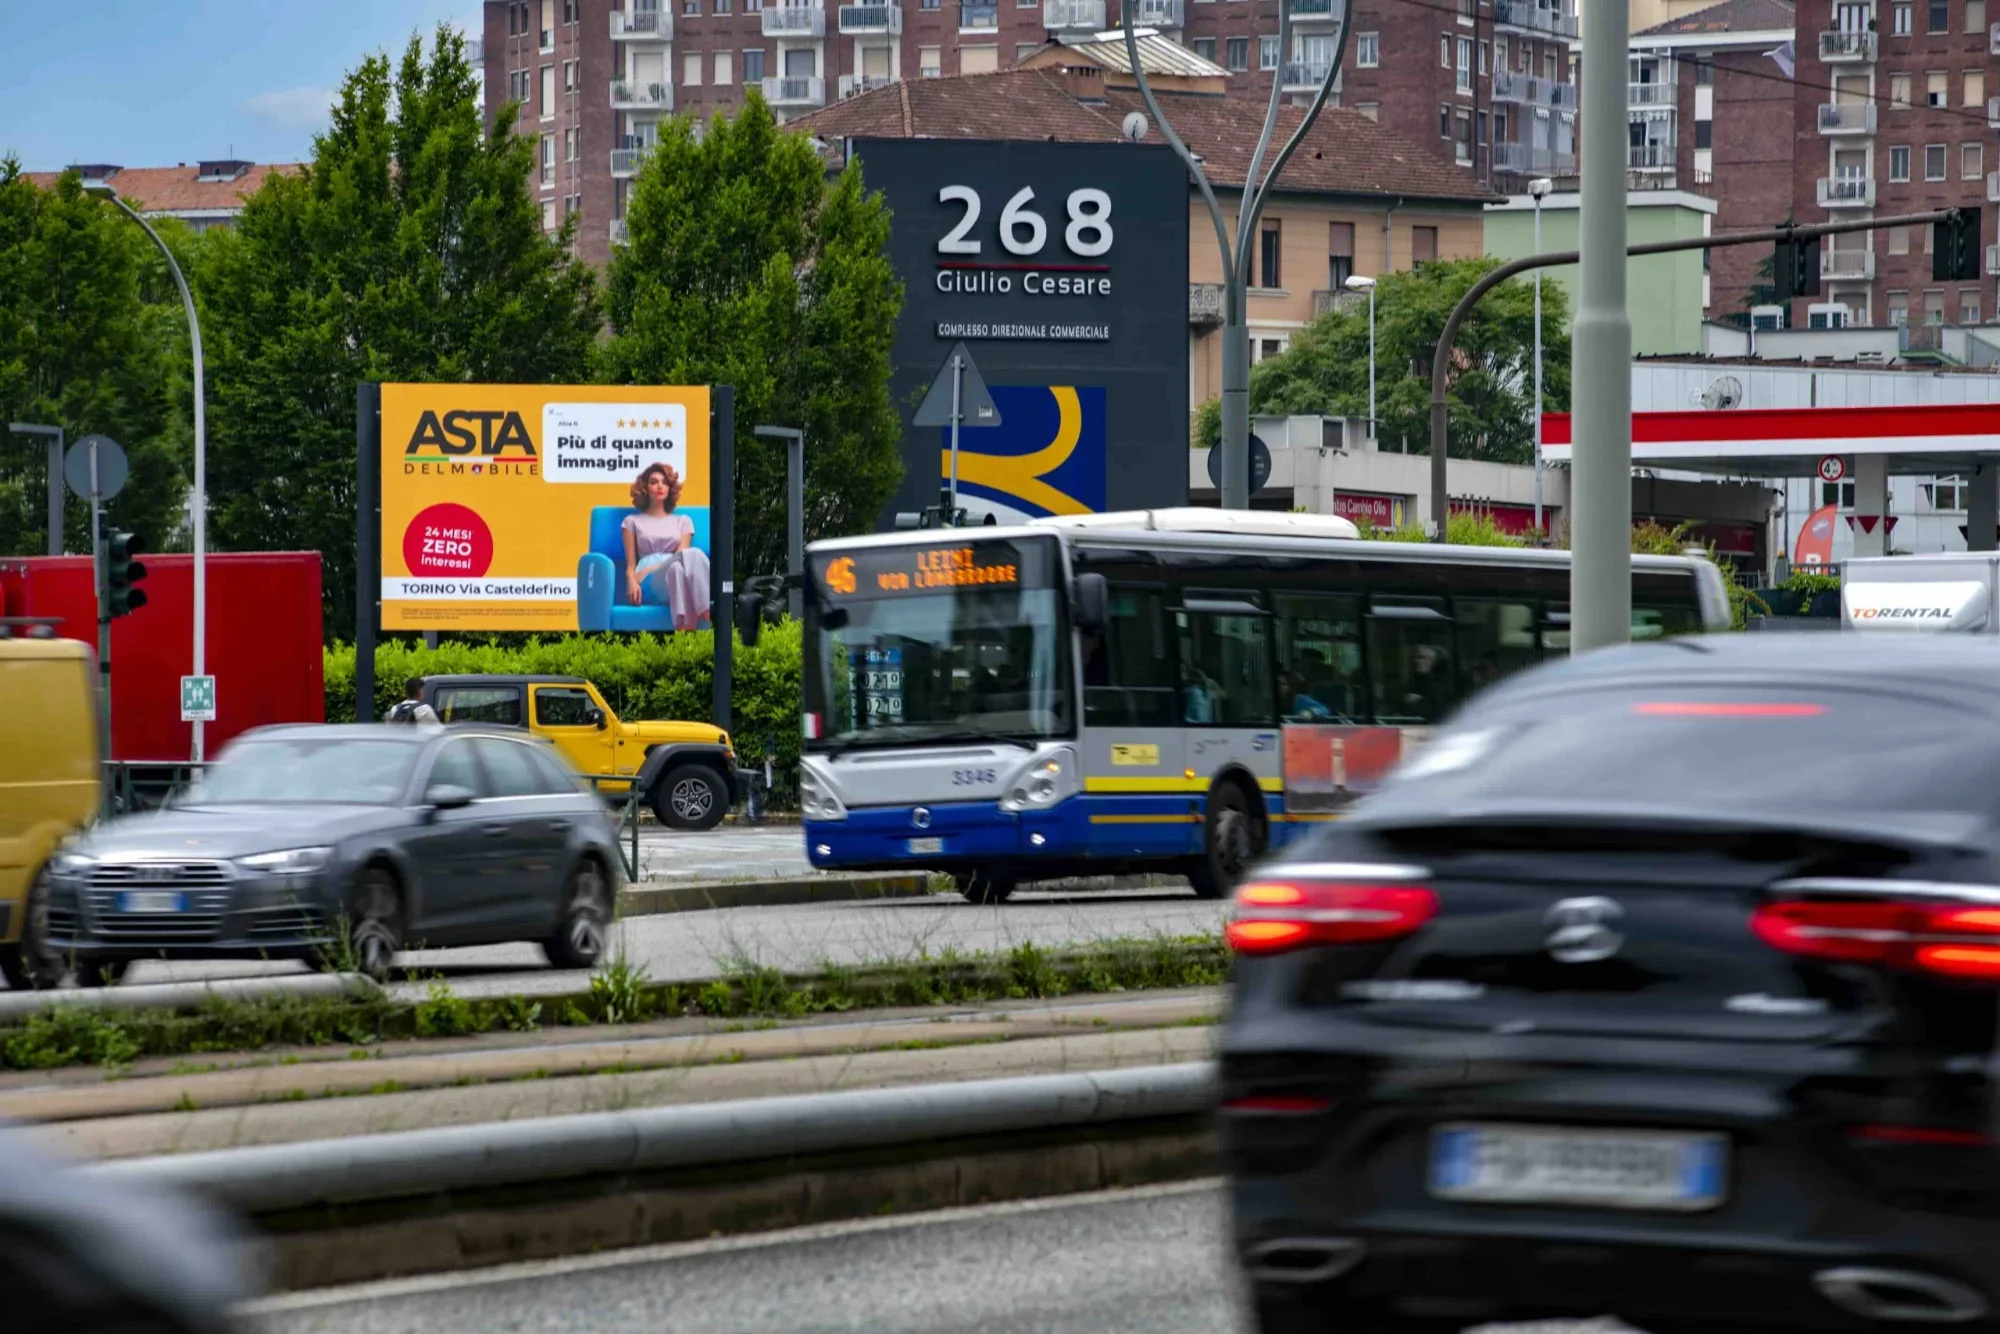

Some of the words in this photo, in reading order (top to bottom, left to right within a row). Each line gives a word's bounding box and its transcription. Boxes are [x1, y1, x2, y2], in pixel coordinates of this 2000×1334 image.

[938, 185, 1114, 257] 268
[936, 270, 1012, 293] Giulio
[1023, 272, 1111, 295] Cesare
[938, 323, 988, 336] COMPLESSO
[992, 324, 1046, 337] DIREZIONALE
[1050, 325, 1109, 339] COMMERCIALE
[405, 410, 537, 455] ASTA
[557, 435, 585, 449] Più
[590, 435, 607, 449] di
[611, 438, 673, 452] quanto
[557, 454, 639, 471] immagini
[1333, 499, 1347, 512] ntro
[1347, 498, 1372, 515] Cambio
[1373, 500, 1387, 515] Olio
[425, 526, 440, 537] 24
[442, 527, 472, 540] MESI
[422, 539, 472, 556] ZERO
[421, 555, 472, 569] interessi
[401, 583, 456, 594] TORINO
[459, 583, 481, 595] Via
[485, 583, 571, 596] Casteldefino
[1853, 607, 1953, 619] TORENTAL
